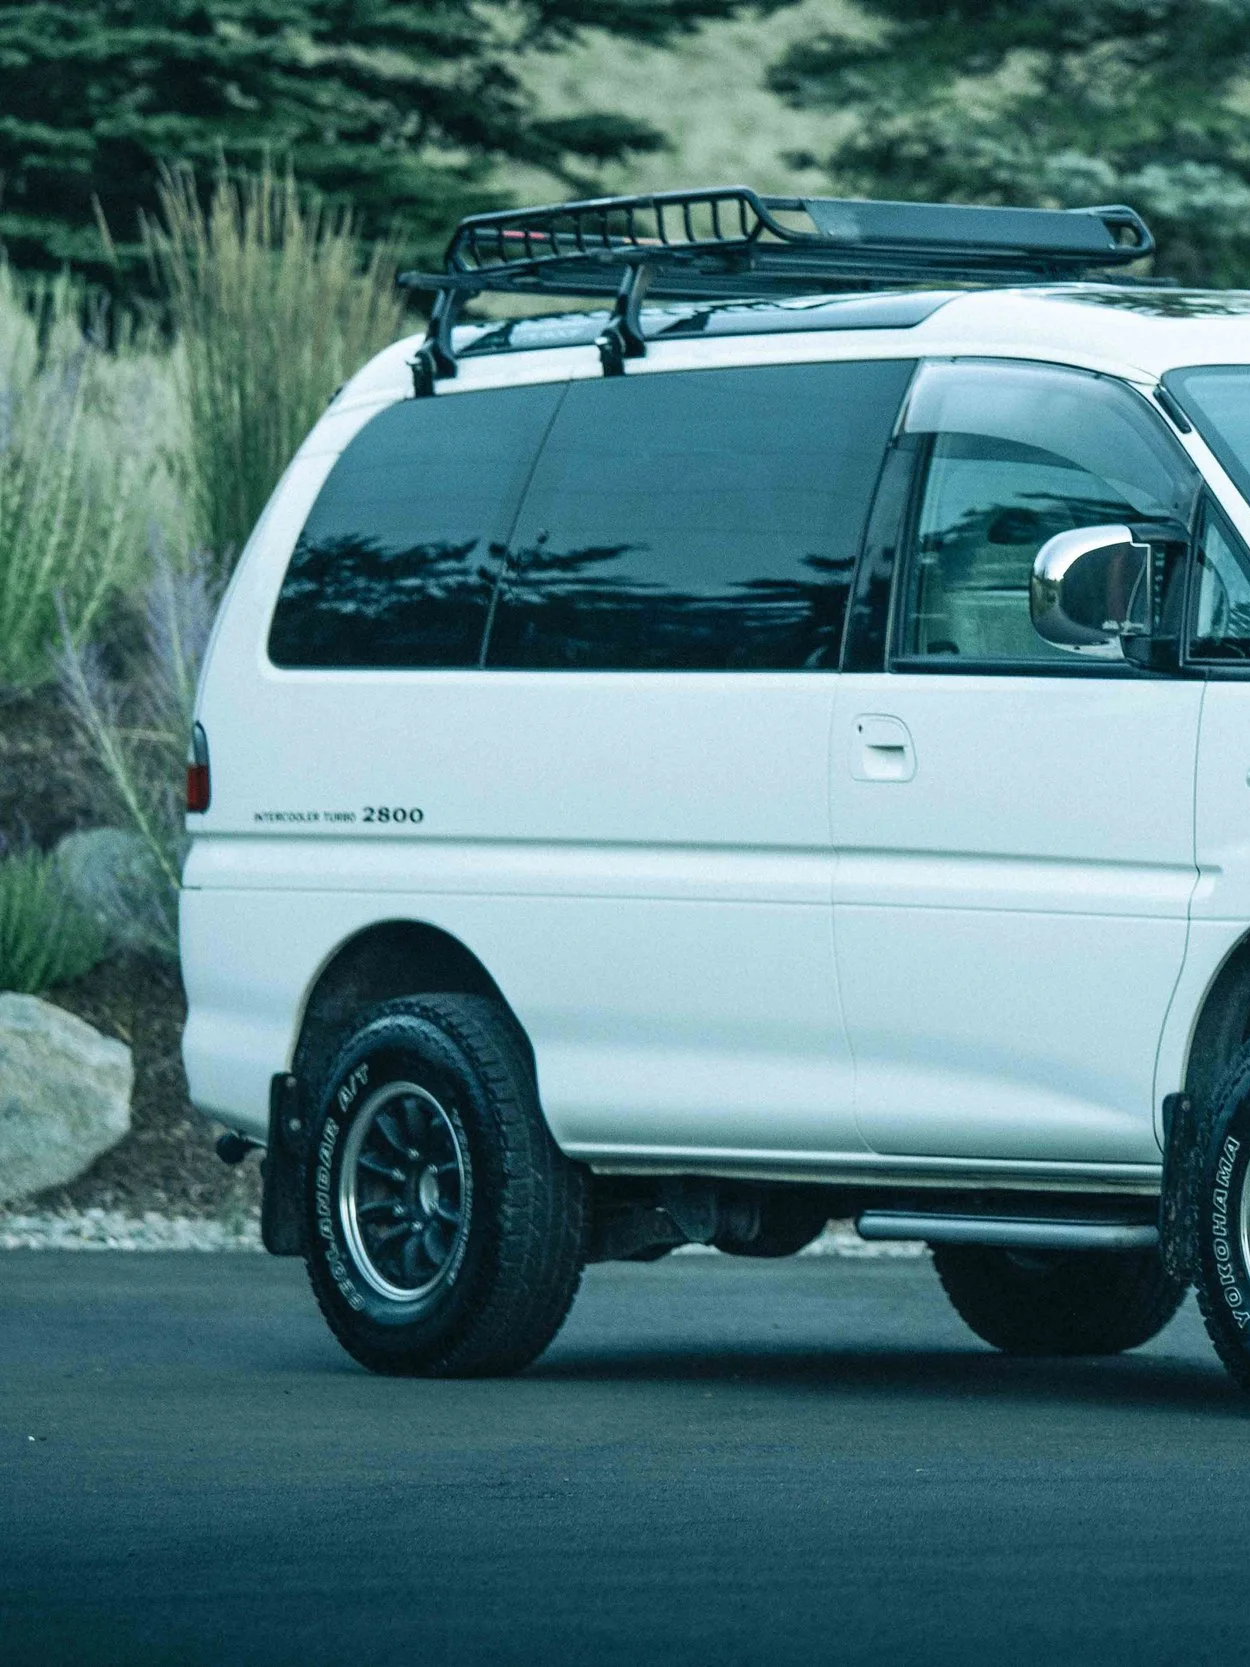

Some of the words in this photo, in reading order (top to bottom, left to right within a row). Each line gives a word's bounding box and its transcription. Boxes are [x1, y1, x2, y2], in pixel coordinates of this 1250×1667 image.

[254, 811, 320, 823] INTERCOOLER
[323, 811, 357, 823] TURBO
[362, 806, 424, 823] 2800
[337, 1062, 369, 1113] A/T
[1212, 1135, 1250, 1329] YOKOHAMA
